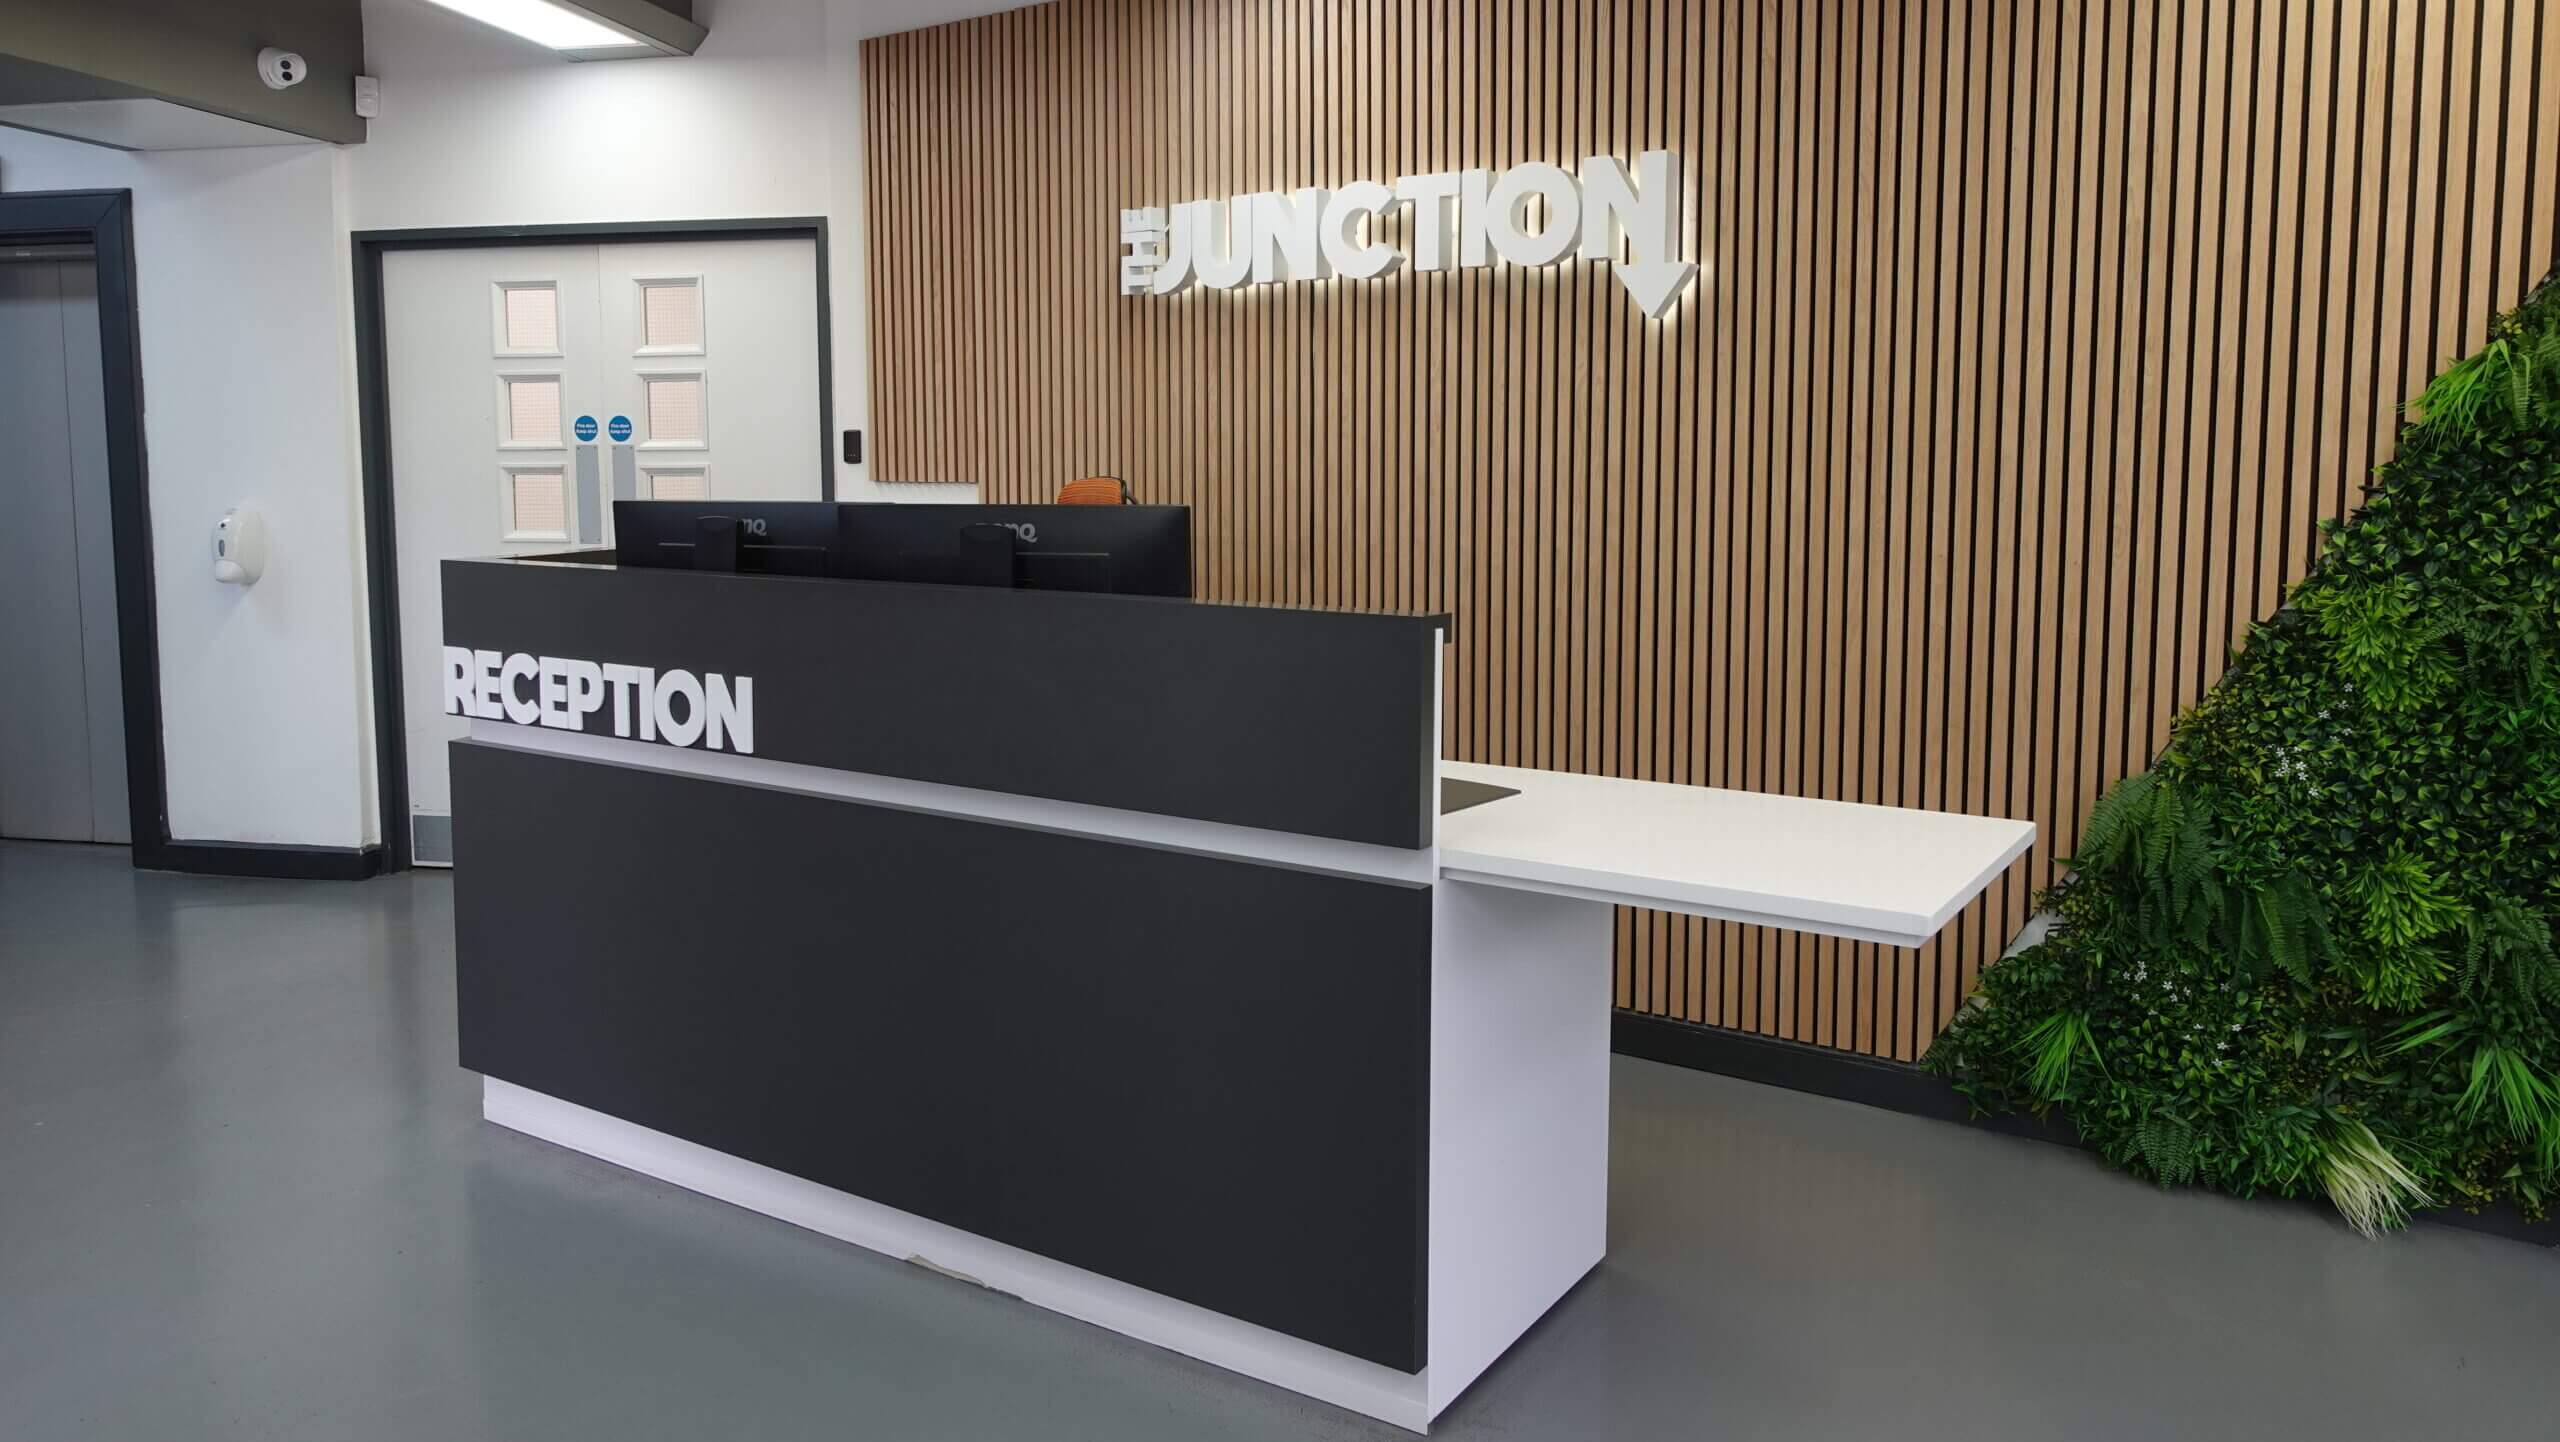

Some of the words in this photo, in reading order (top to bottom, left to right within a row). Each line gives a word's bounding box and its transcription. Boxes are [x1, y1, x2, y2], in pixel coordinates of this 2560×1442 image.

[1120, 207, 1163, 295] THE
[1153, 149, 1698, 319] JUNCTION
[741, 518, 767, 536] nQ
[443, 645, 754, 754] RECEPTION
